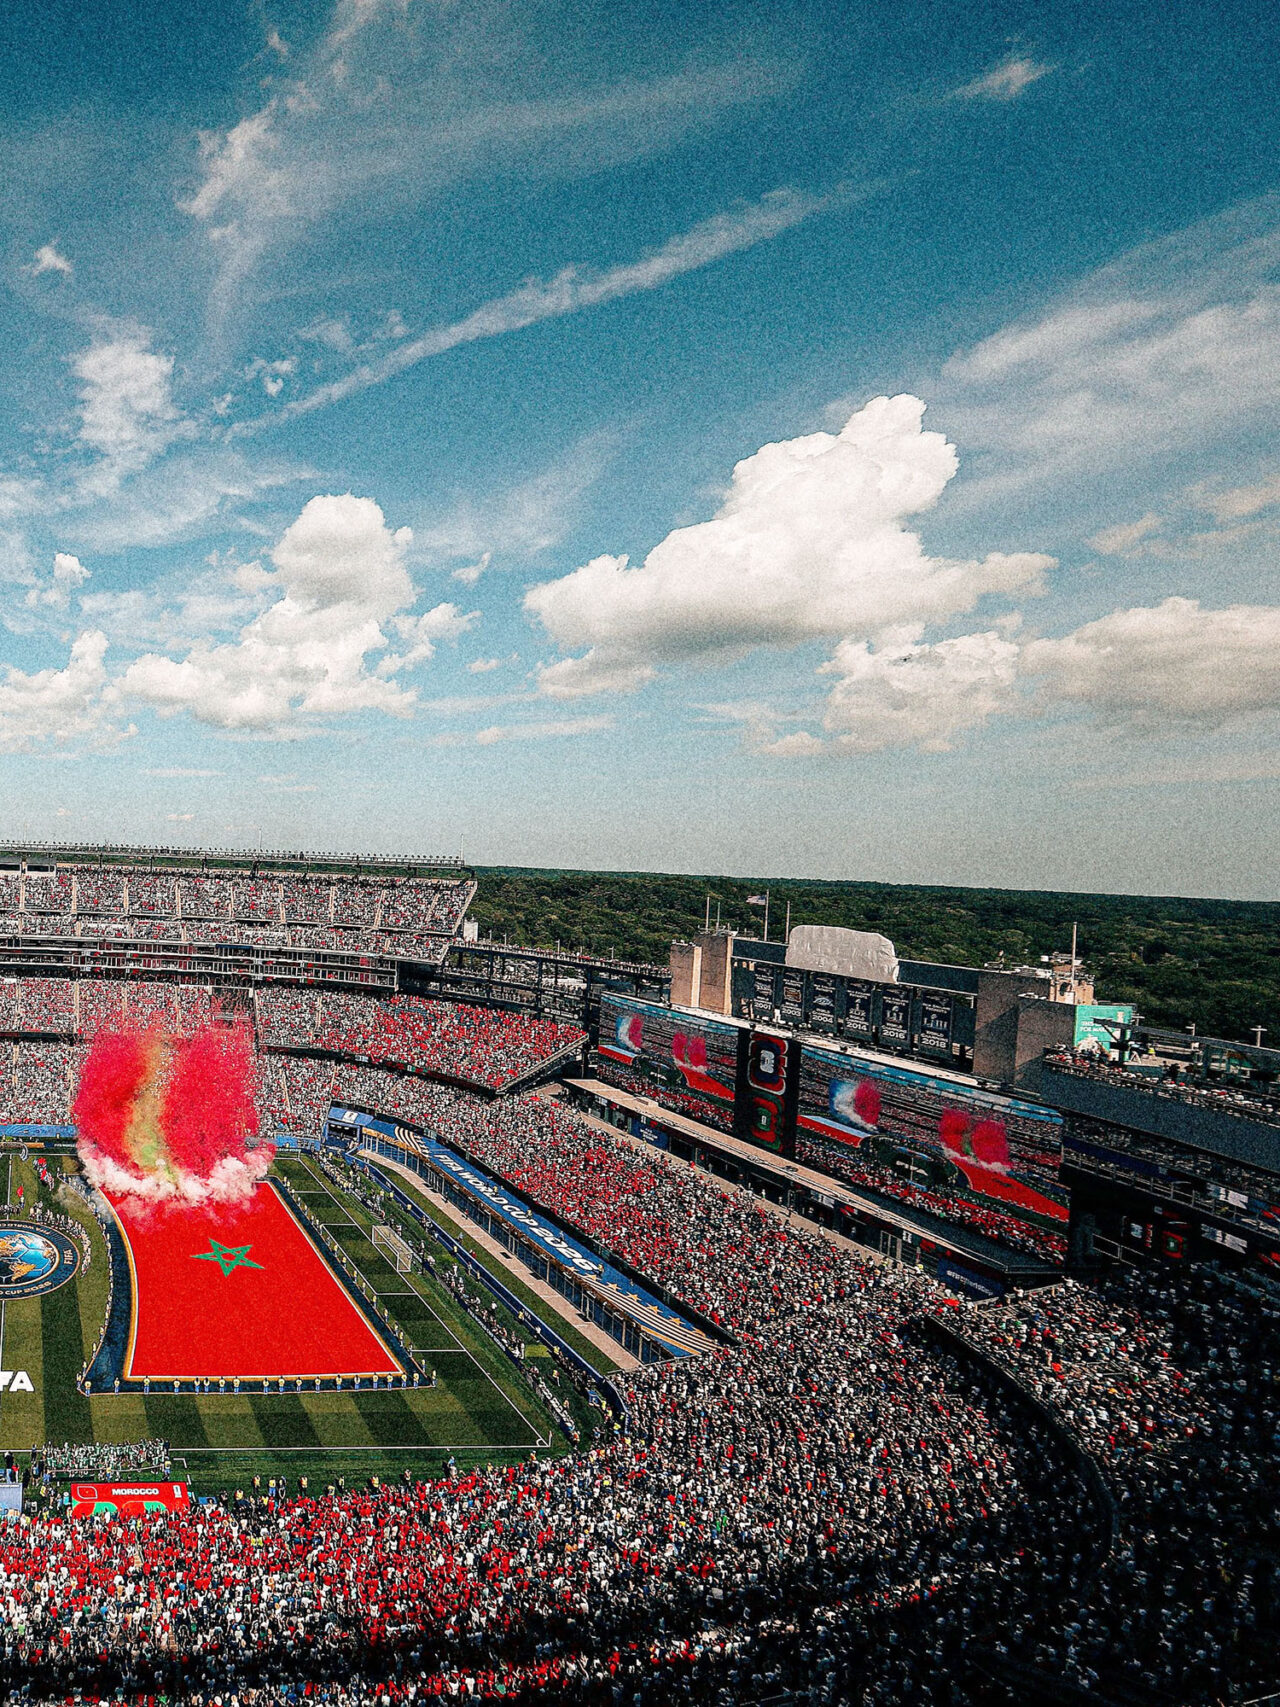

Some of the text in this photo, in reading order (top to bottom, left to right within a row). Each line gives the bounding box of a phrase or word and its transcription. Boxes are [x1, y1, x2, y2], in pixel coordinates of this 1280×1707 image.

[812, 1014, 833, 1023] 2004
[847, 1022, 867, 1030] 2014
[882, 1030, 906, 1039] 2016
[922, 1038, 946, 1048] 2018
[434, 1154, 598, 1271] FIFA WORLD CUP 2026
[64, 1248, 73, 1265] FIFA
[24, 1281, 52, 1292] 2026
